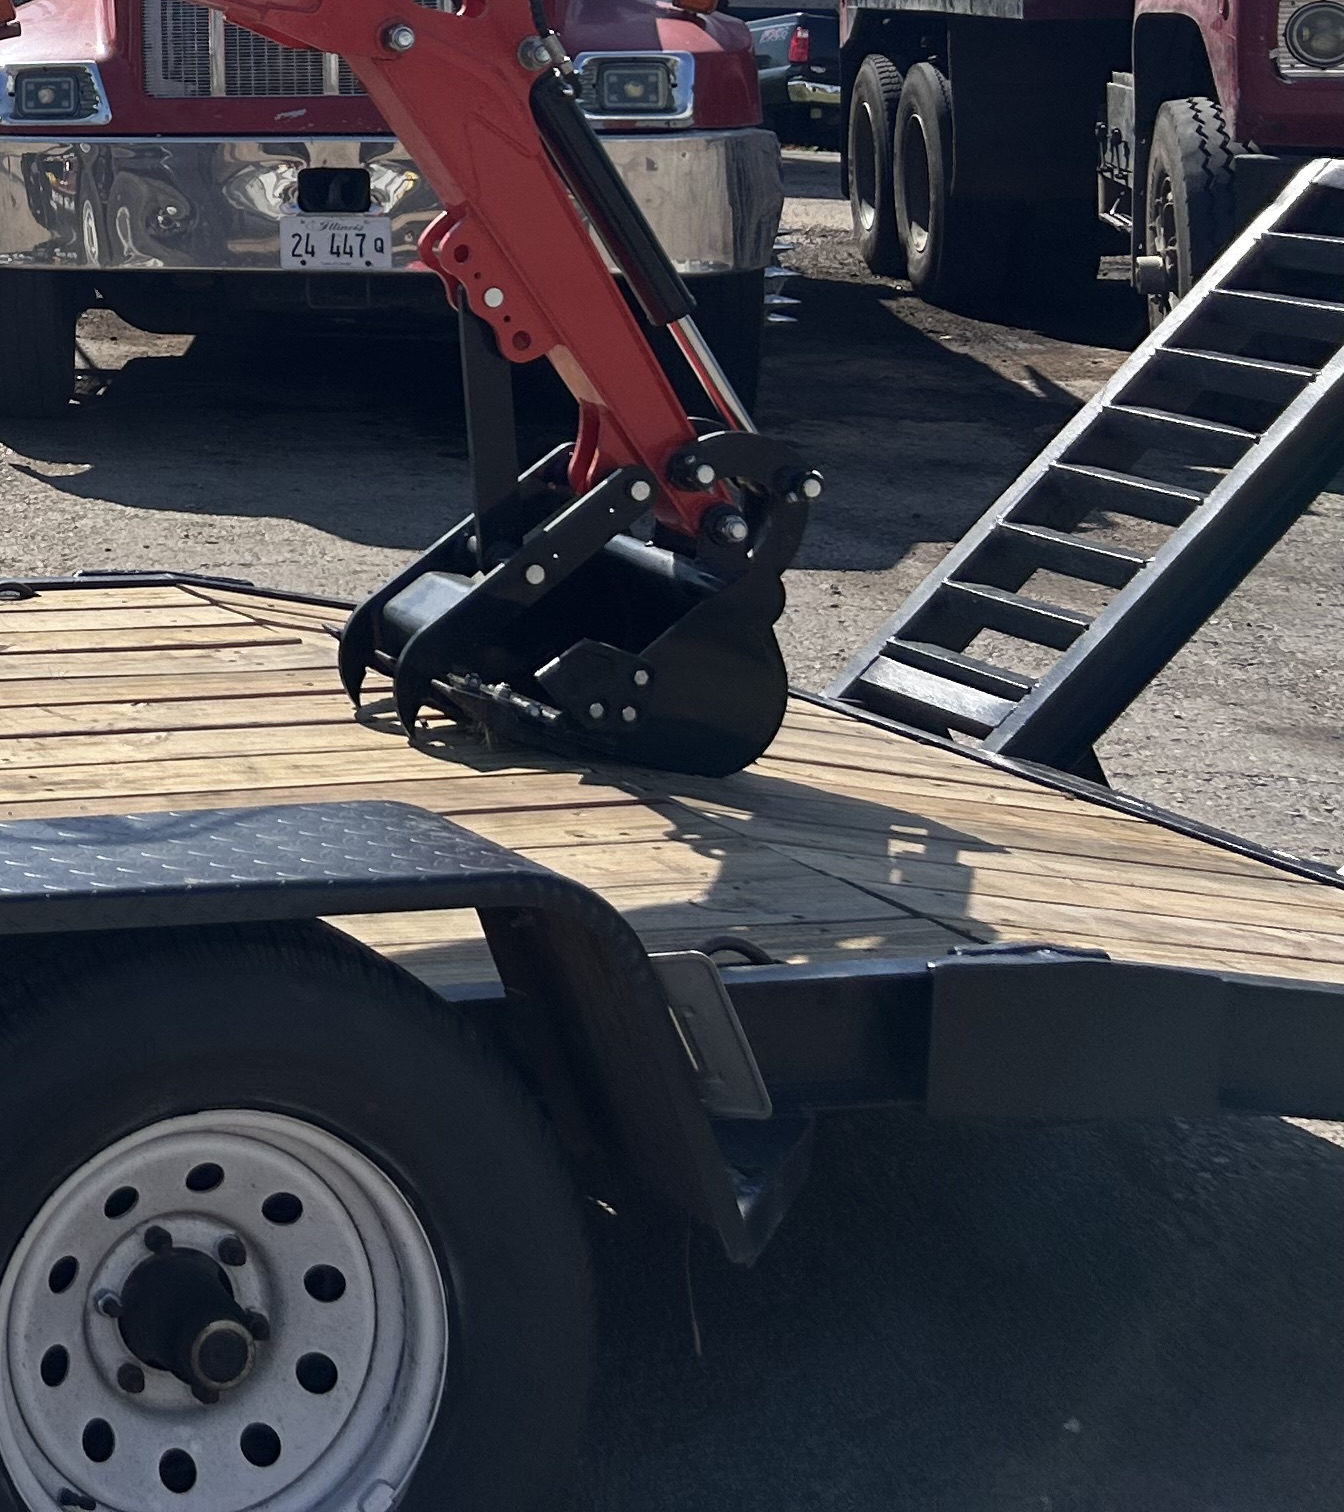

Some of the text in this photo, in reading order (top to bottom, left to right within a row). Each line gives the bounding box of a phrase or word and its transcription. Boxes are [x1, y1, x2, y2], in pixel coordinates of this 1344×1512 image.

[291, 232, 384, 258] 24 447 Q
